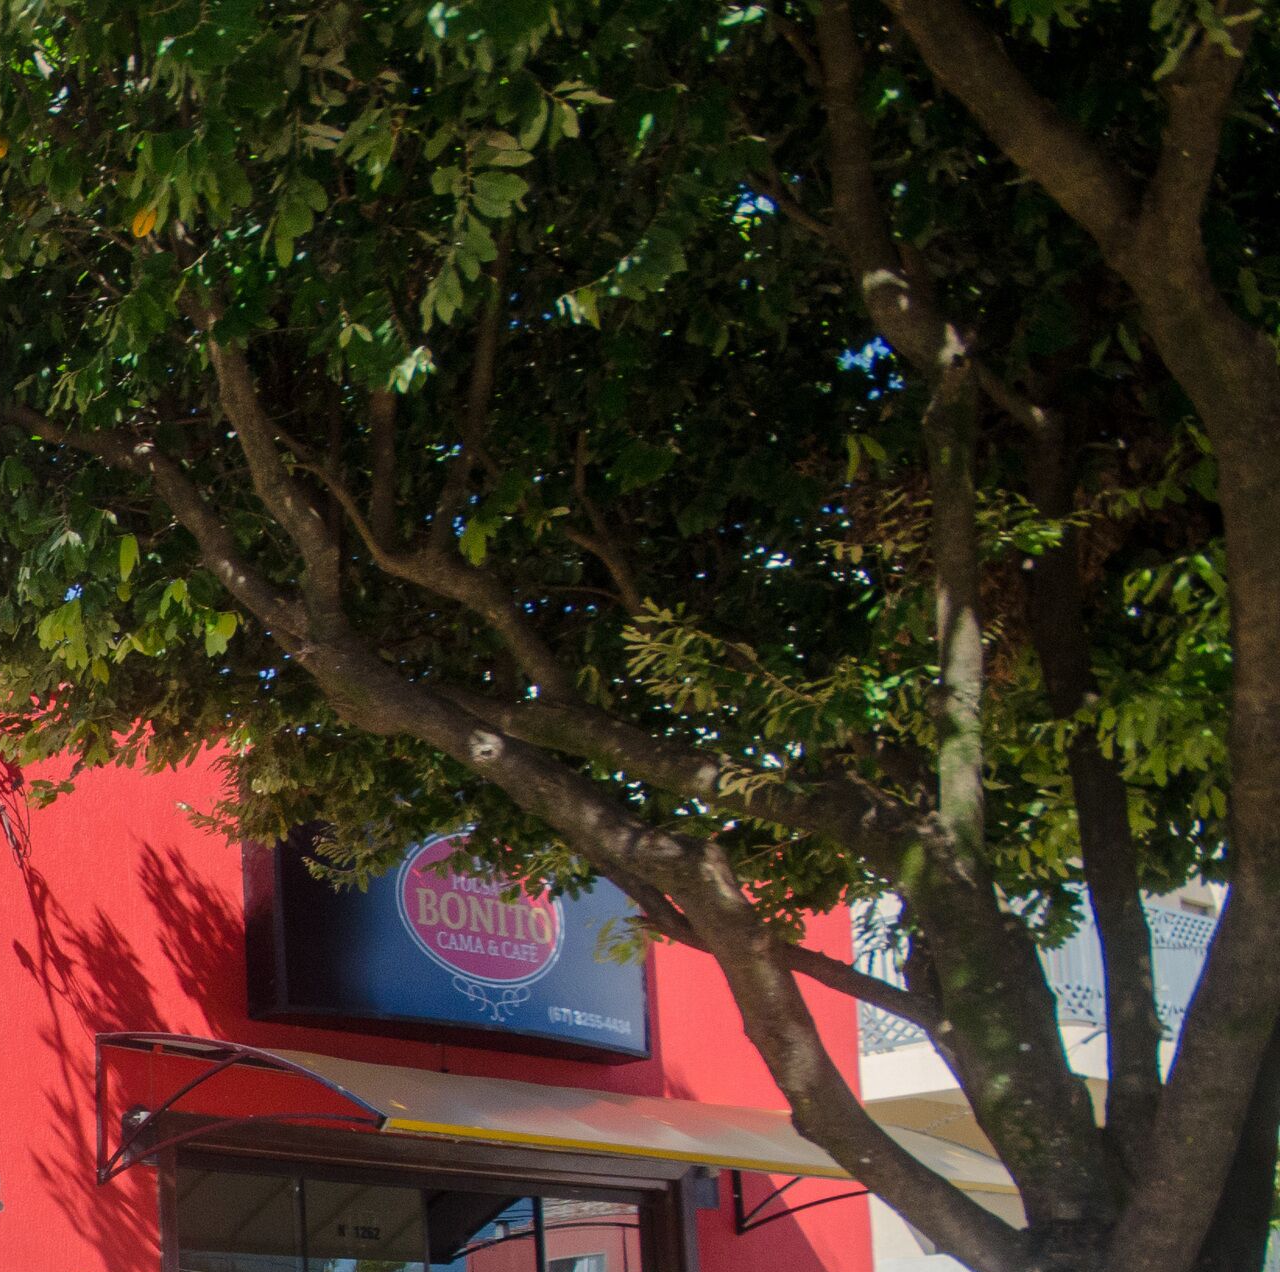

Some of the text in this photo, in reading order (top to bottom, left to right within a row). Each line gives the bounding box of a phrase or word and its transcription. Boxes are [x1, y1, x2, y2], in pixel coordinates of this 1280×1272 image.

[416, 887, 552, 945] BONITO
[436, 931, 485, 955] CAMA
[487, 940, 500, 956] &
